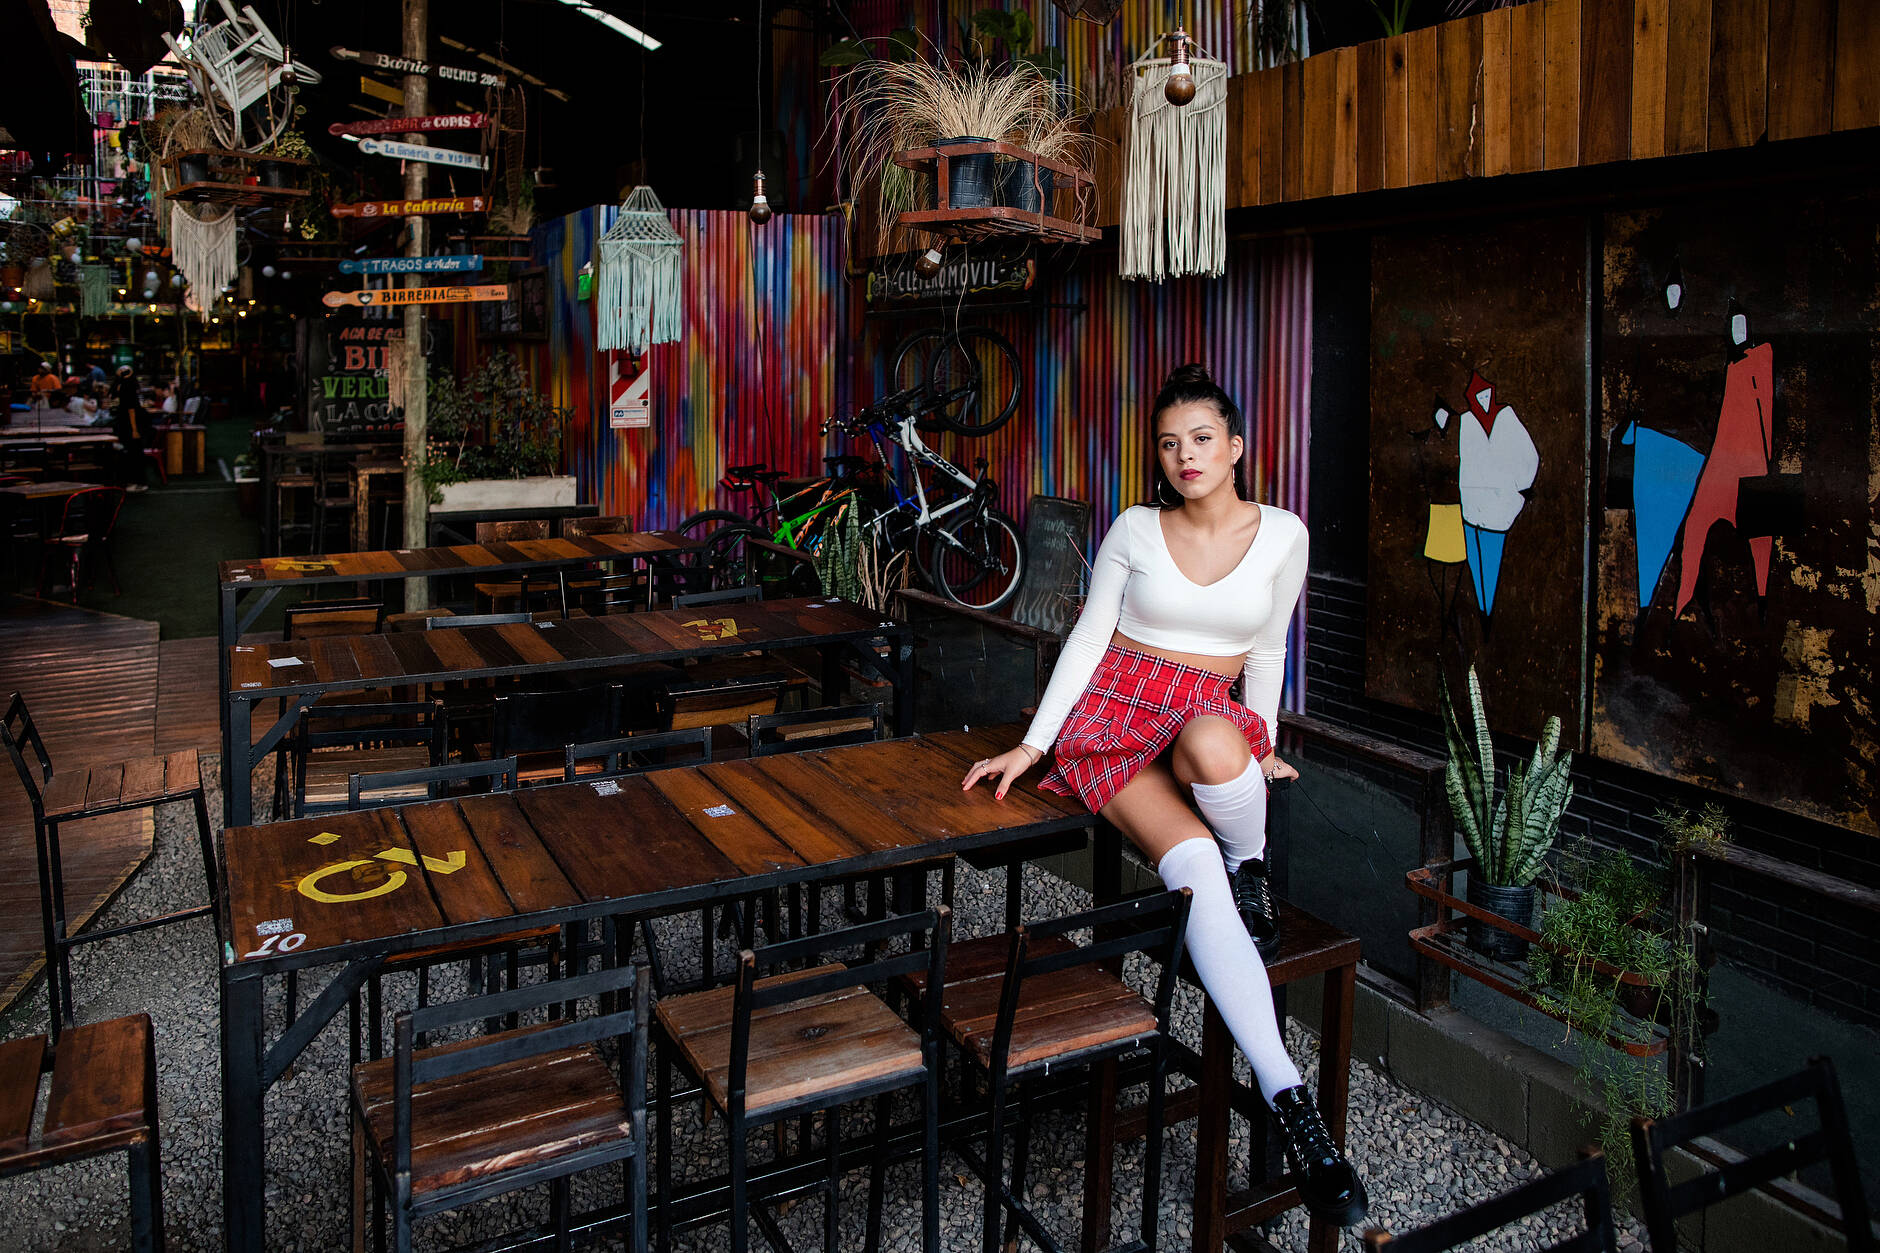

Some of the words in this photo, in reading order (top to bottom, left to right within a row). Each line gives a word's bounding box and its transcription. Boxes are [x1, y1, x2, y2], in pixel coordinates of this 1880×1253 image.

[382, 202, 400, 214] La
[371, 258, 422, 272] TRAGOS
[382, 287, 446, 303] BIRRERIA
[244, 933, 307, 959] 10
